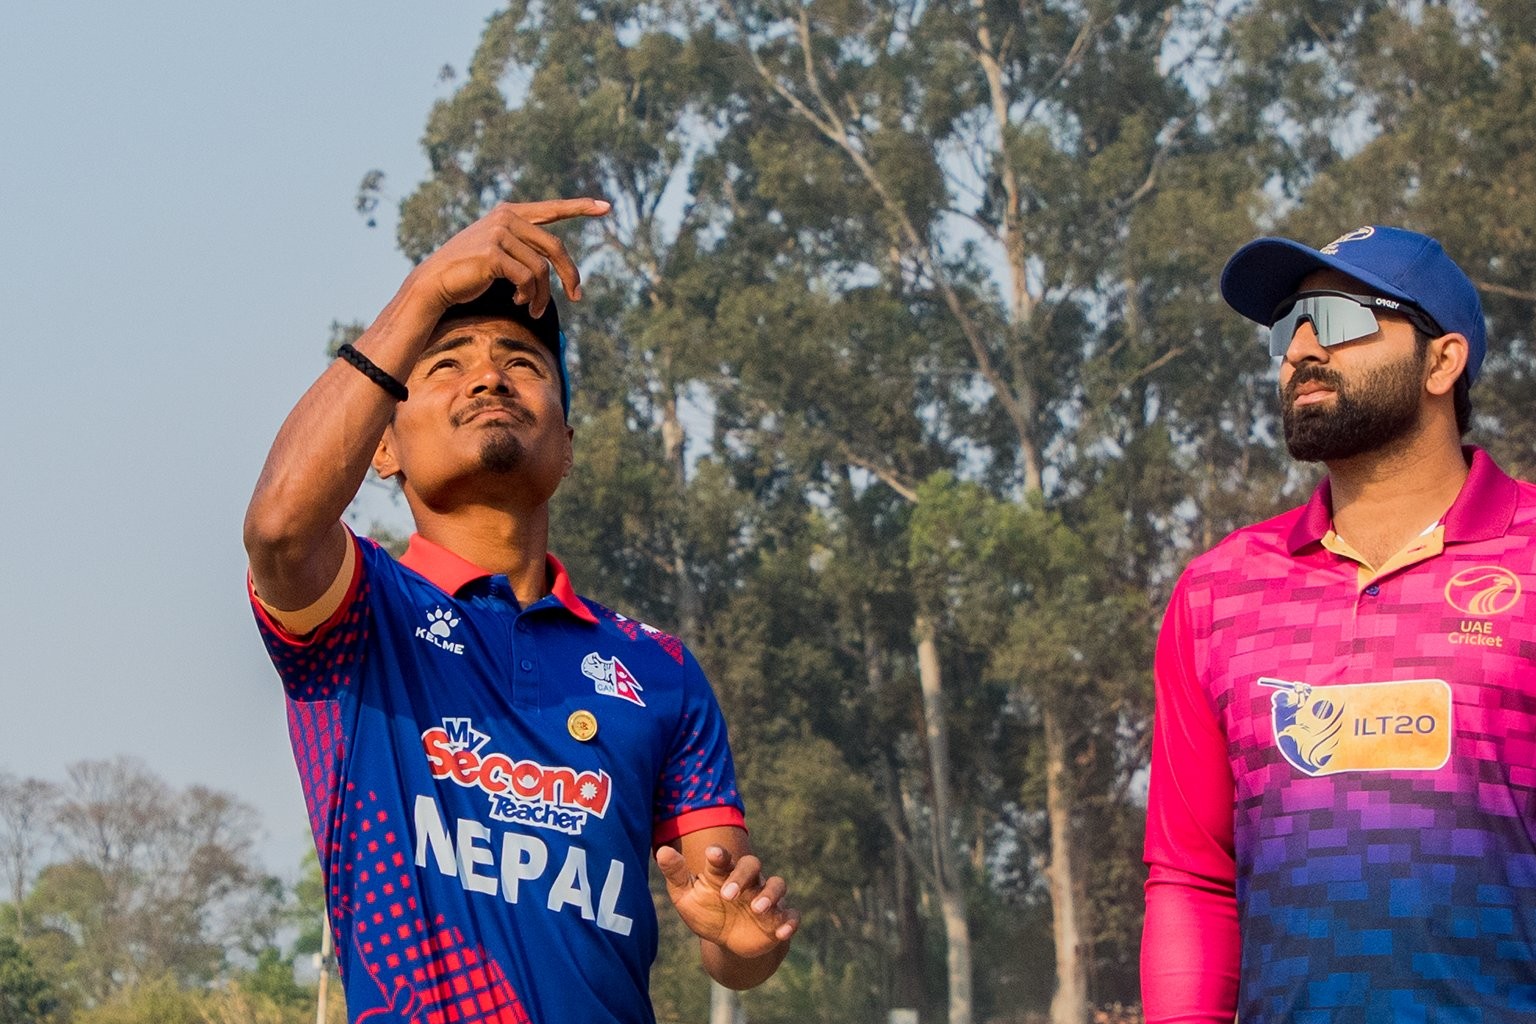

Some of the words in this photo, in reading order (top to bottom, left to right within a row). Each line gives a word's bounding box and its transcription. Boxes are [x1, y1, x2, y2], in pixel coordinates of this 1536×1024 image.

[415, 626, 465, 655] KELME
[1447, 631, 1503, 648] Cricket
[1460, 620, 1493, 634] UAE
[443, 718, 489, 751] My
[1353, 714, 1436, 737] ILT20
[422, 727, 611, 819] Second
[489, 795, 587, 834] Teacher
[415, 794, 633, 937] NEPAL
